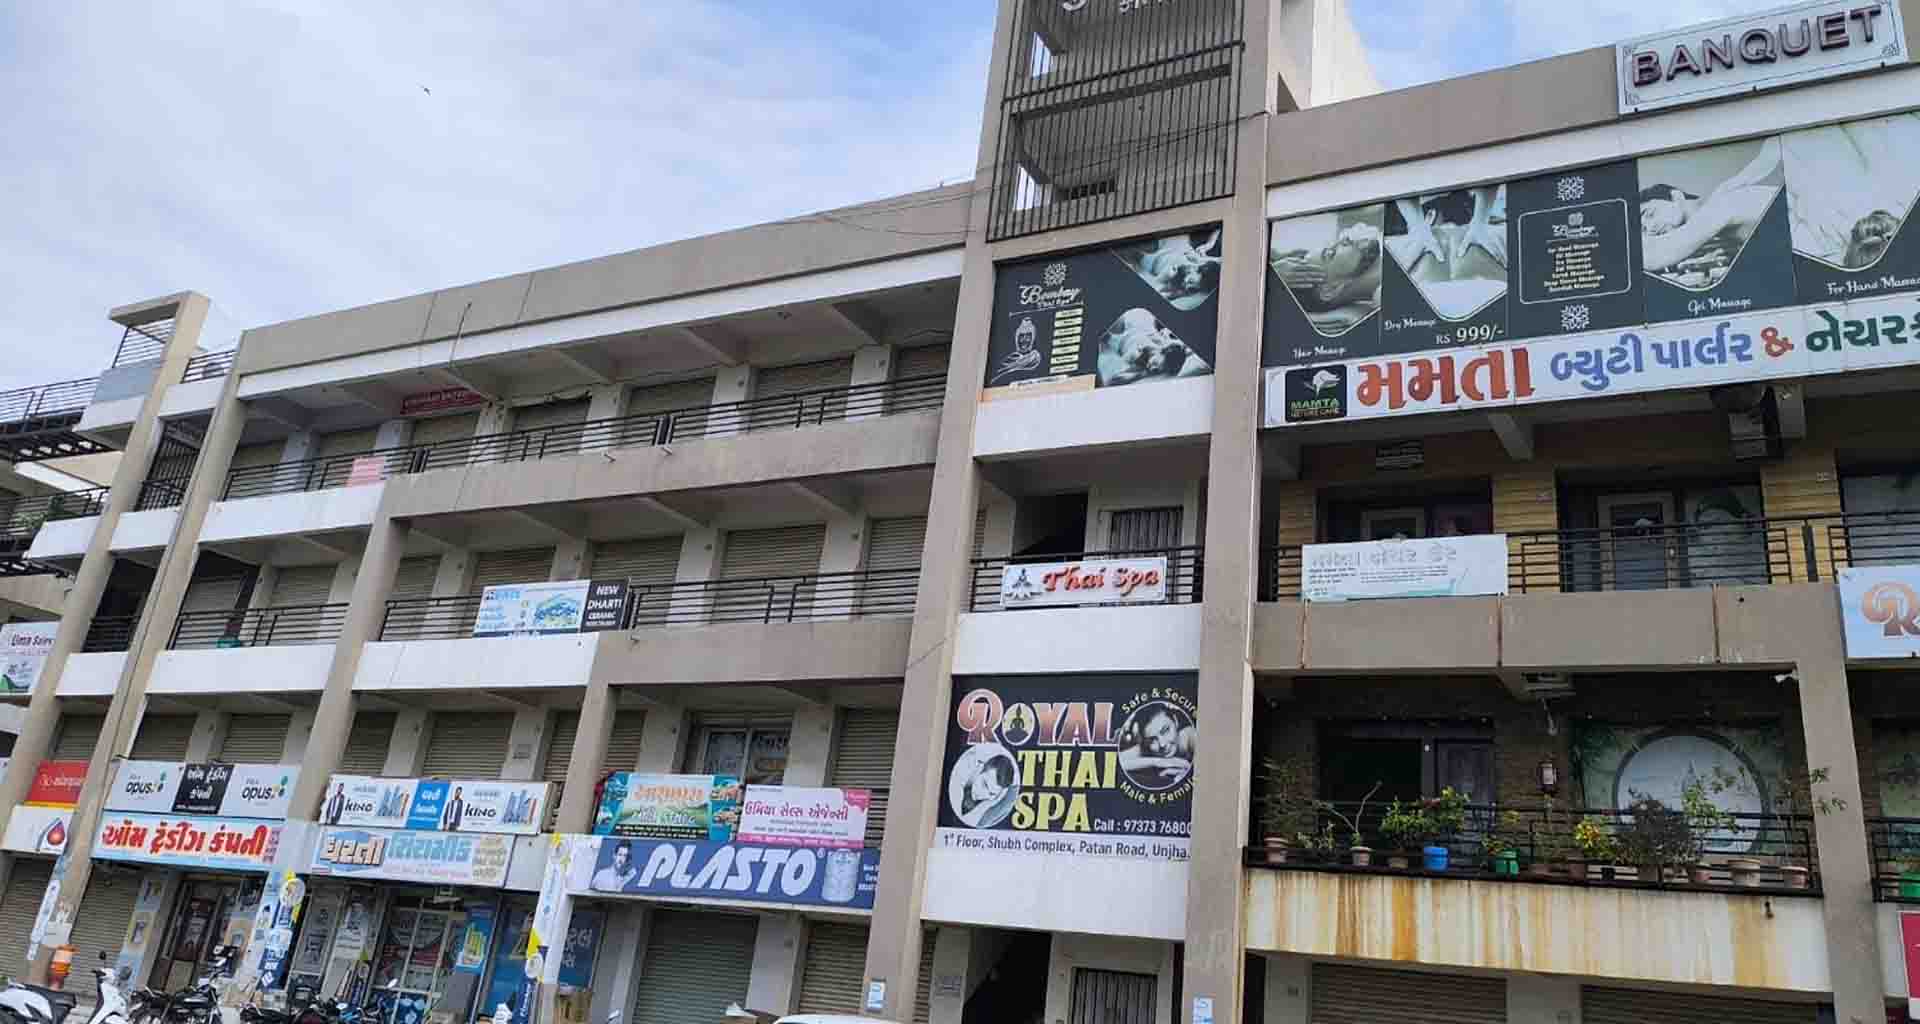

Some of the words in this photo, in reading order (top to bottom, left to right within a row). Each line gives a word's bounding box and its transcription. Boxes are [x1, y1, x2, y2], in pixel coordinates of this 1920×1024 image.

[1632, 5, 1881, 87] BANQUET
[1435, 334, 1451, 345] RS
[1455, 323, 1504, 342] 999/-
[1550, 333, 1645, 391] બ્યુટી
[1650, 322, 1753, 370] પાર્લર
[1760, 326, 1795, 358] &
[1356, 347, 1535, 410] મમતા
[1290, 398, 1340, 410] MAMTA
[596, 585, 619, 595] NEW
[1043, 567, 1105, 592] Thai
[1113, 568, 1159, 597] Spa
[587, 599, 622, 610] DHARTI
[1121, 692, 1148, 714] Safe
[957, 688, 1120, 747] ROYAL
[1017, 750, 1118, 789] THAI
[1120, 781, 1146, 803] Male
[1159, 777, 1198, 804] Femal
[344, 799, 373, 812] KING
[464, 802, 497, 818] KING
[1010, 792, 1091, 832] SPA
[1094, 818, 1114, 832] Call
[1123, 819, 1157, 834] 97373
[1159, 820, 1193, 835] 76800
[956, 835, 984, 850] Floor,
[986, 836, 1021, 850] Shubh
[1024, 838, 1076, 854] Complex,
[1079, 840, 1112, 855] Patan
[1115, 842, 1149, 858] Road,
[638, 843, 817, 897] PLASTO
